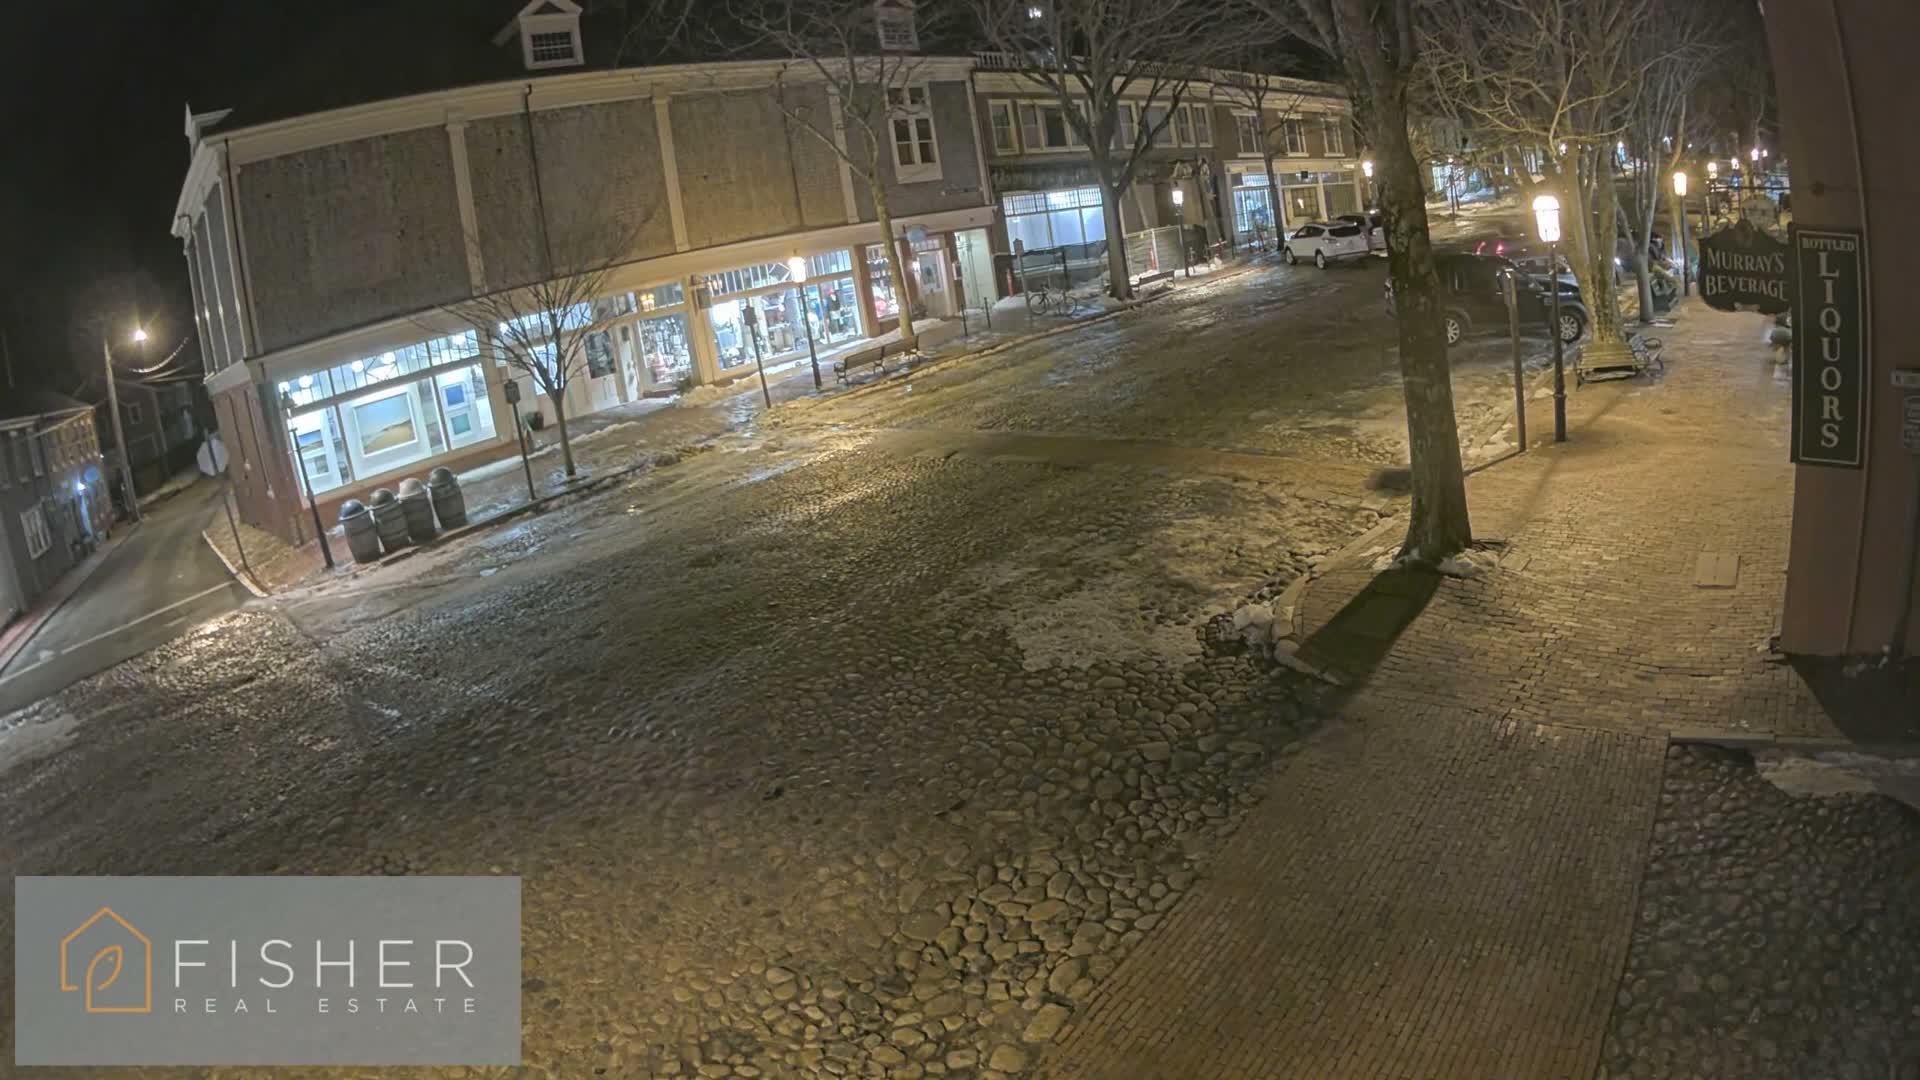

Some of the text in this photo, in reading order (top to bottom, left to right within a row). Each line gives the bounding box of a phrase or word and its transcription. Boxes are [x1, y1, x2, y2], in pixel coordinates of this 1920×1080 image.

[1801, 237, 1855, 251] BOTTLED
[1706, 247, 1785, 273] MURRAY'S
[1705, 274, 1789, 301] BEVERAGE
[1818, 251, 1843, 448] LIQUORS
